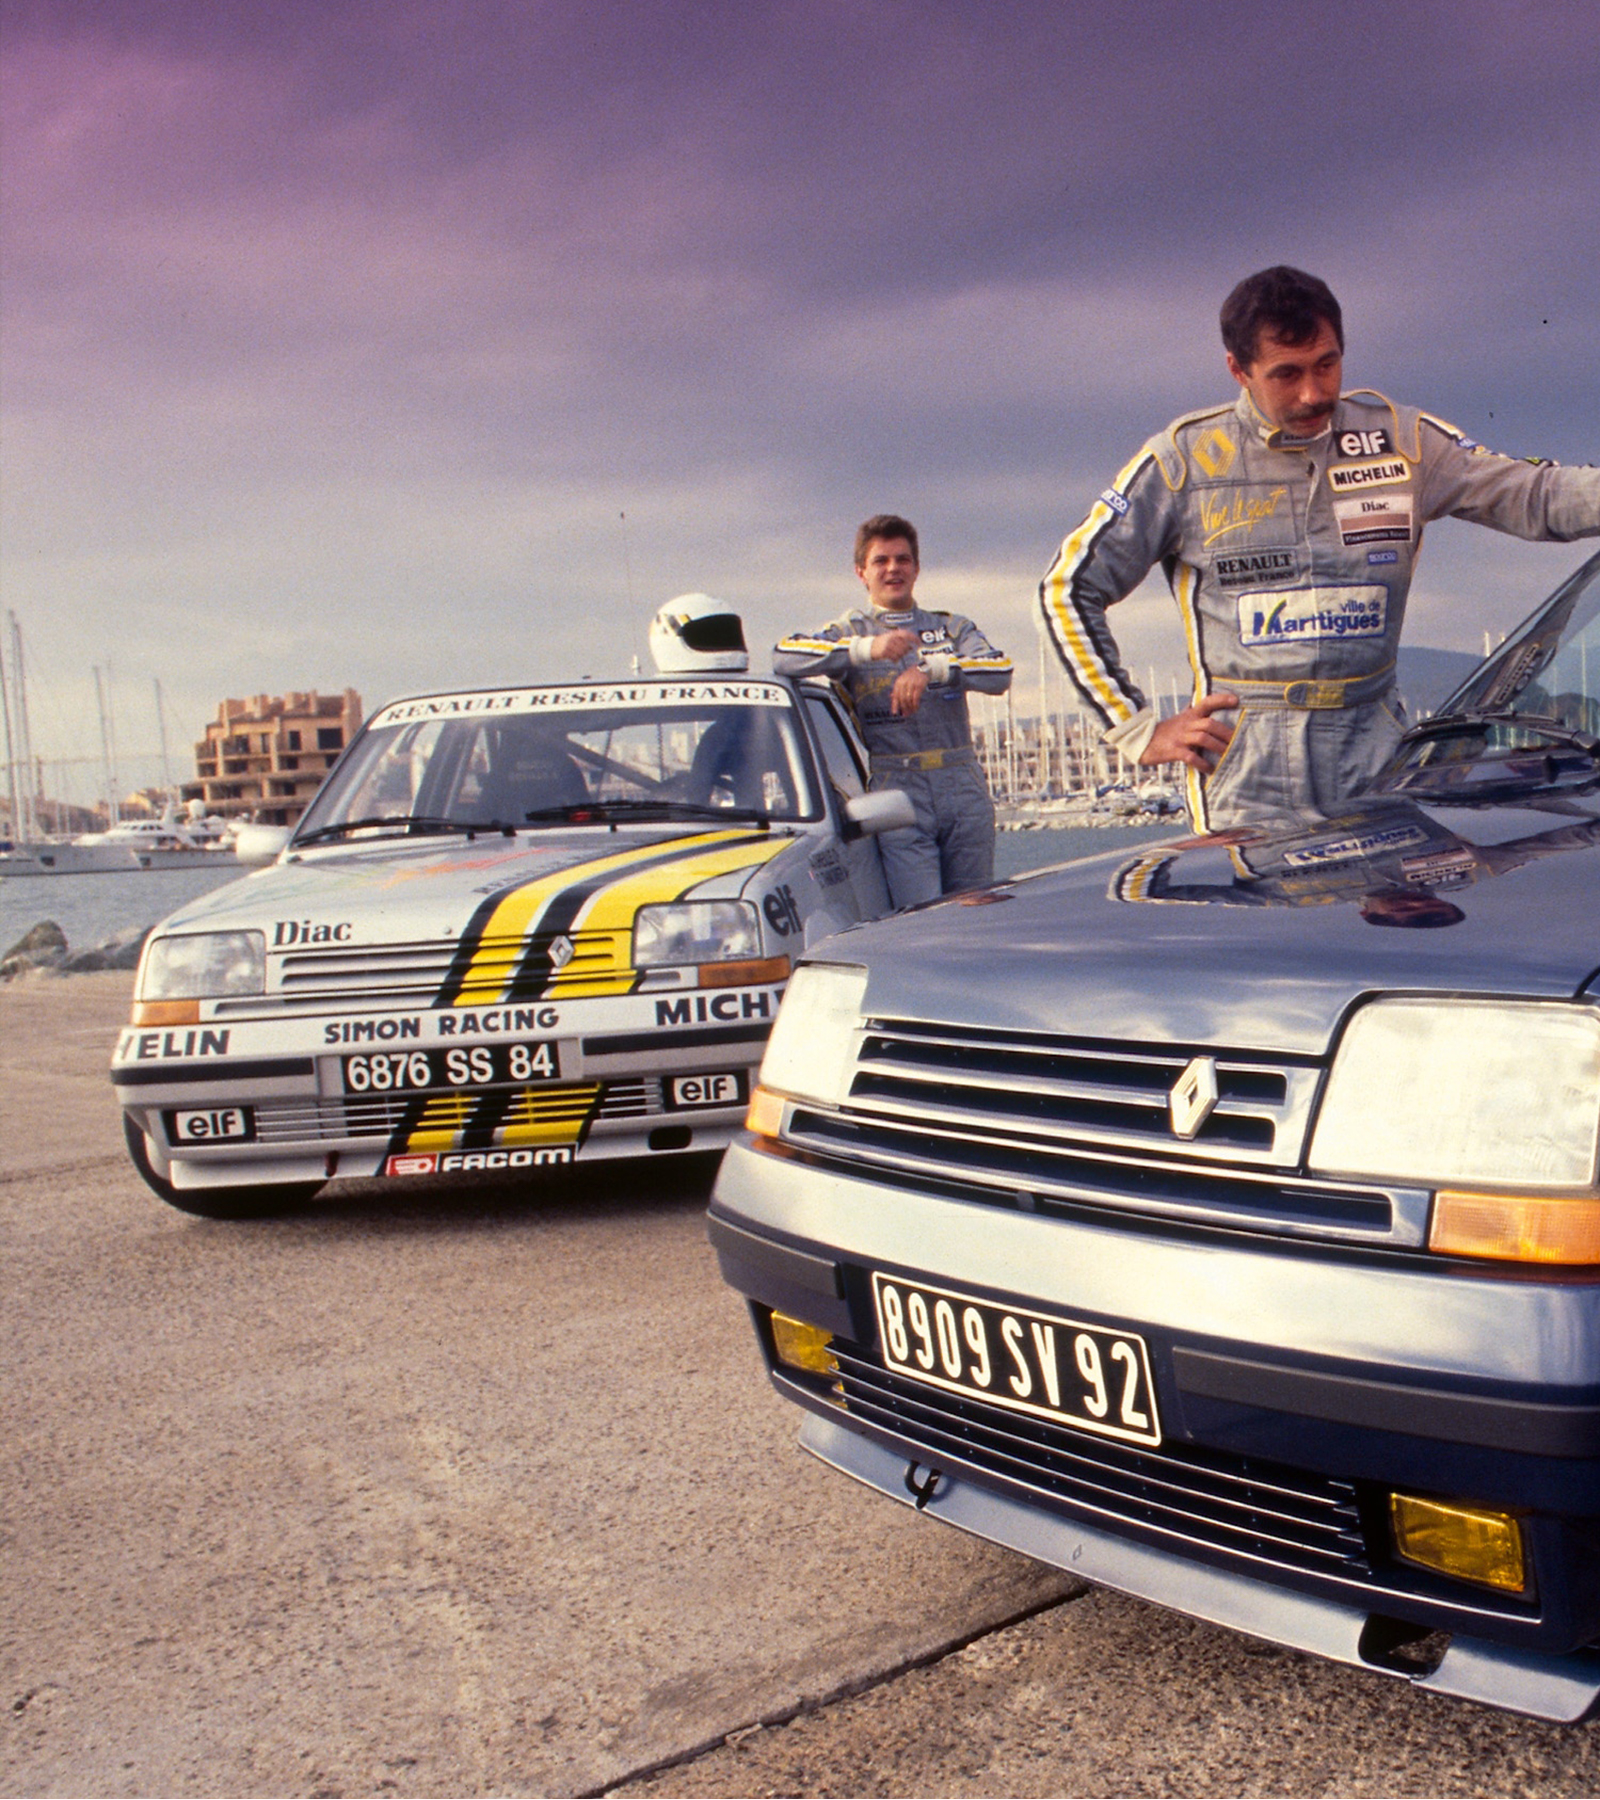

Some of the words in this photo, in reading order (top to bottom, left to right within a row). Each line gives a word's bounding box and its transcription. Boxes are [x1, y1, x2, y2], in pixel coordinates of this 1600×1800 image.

[1341, 431, 1385, 456] elf
[1333, 462, 1406, 486] MICHELIN
[1361, 501, 1390, 512] Diac
[1216, 553, 1292, 575] RENAULT
[1340, 600, 1366, 613] ville
[1368, 600, 1380, 612] de
[387, 696, 519, 721] RENAULT
[529, 689, 647, 706] RESEAU
[659, 687, 780, 702] FRANCE
[763, 884, 803, 937] elf
[273, 919, 352, 946] Diac
[324, 1017, 421, 1044] SIMON
[437, 1008, 560, 1036] RACING
[347, 1051, 431, 1091] 6876
[446, 1047, 494, 1085] SS
[509, 1043, 554, 1080] 84
[680, 1076, 727, 1101] elf
[186, 1110, 236, 1137] elf
[443, 1148, 571, 1171] FACOM
[882, 1284, 991, 1388] 8909
[1002, 1315, 1061, 1407] SV
[1074, 1333, 1149, 1430] 92
